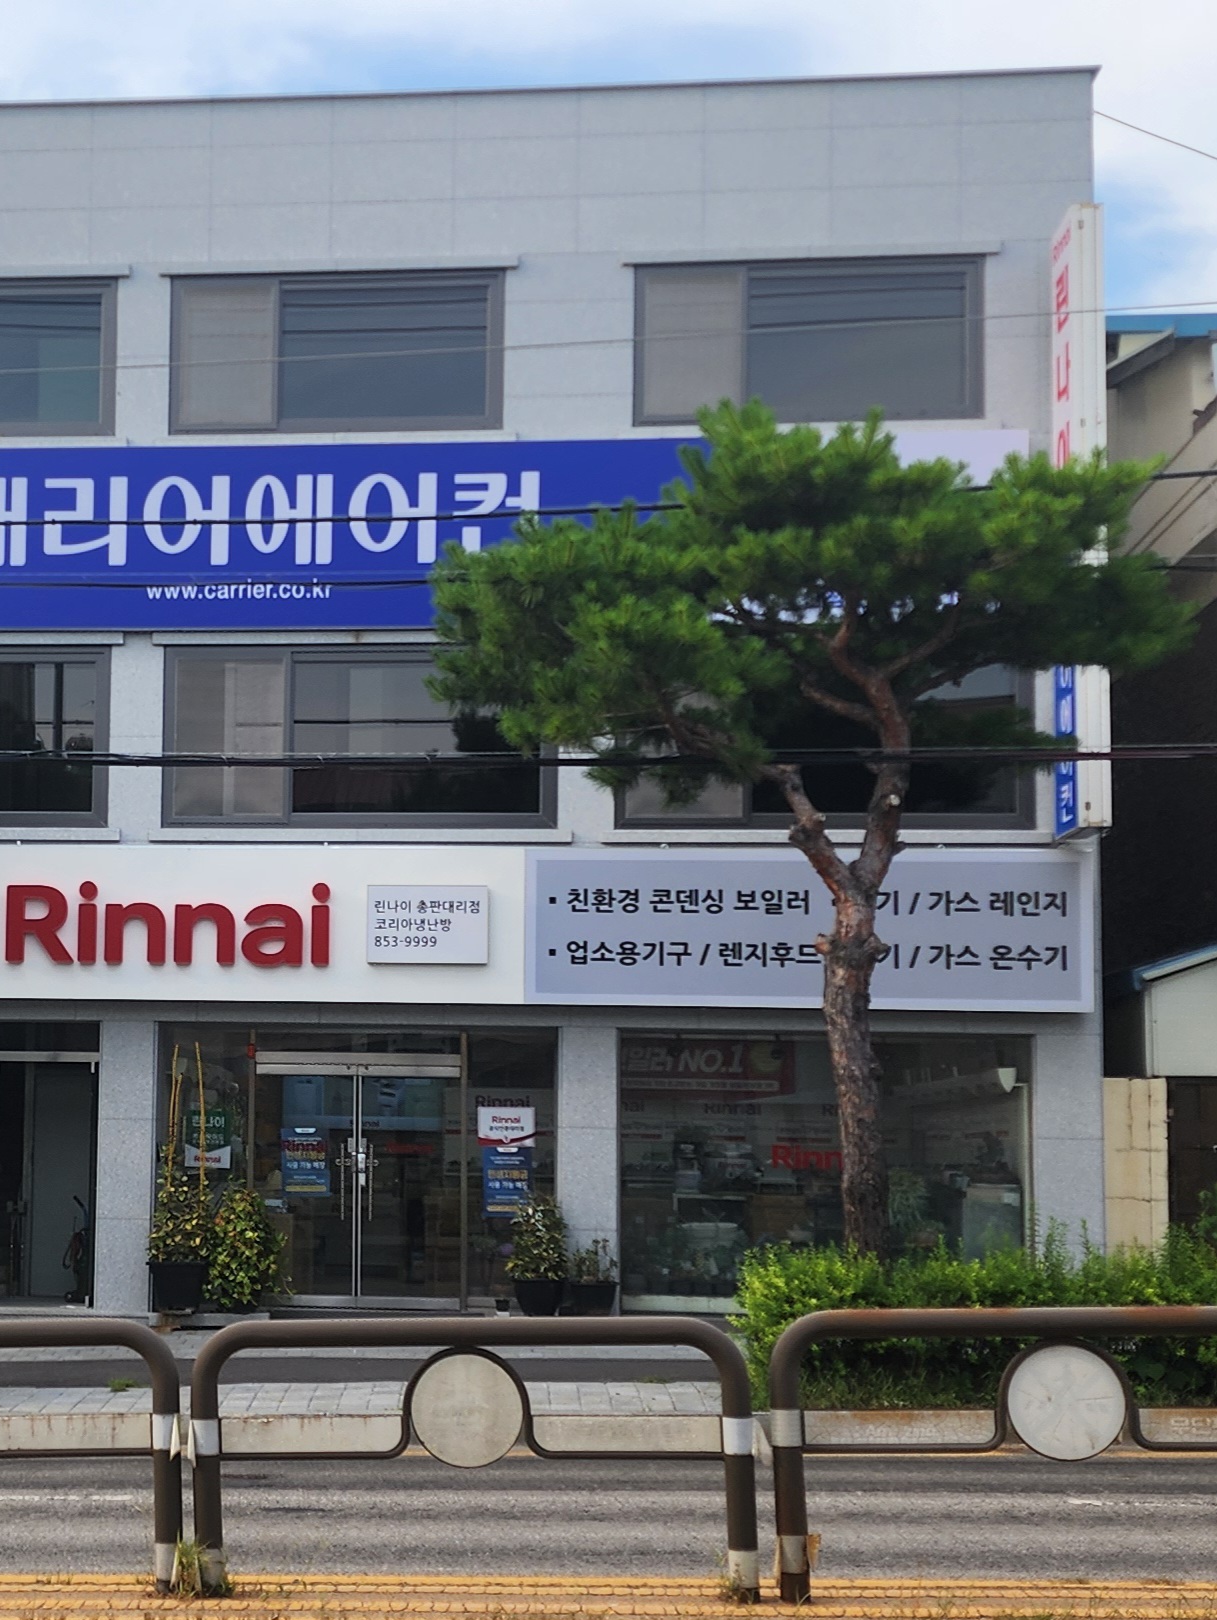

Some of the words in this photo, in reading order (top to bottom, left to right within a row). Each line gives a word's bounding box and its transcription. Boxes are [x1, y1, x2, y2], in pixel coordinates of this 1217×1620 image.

[146, 577, 333, 600] www.carrier.co.kr
[374, 899, 412, 914] 린나이
[416, 899, 481, 914] 총판대리점
[567, 888, 641, 914] 친환경
[649, 888, 724, 914] 콘덴싱
[733, 889, 810, 915] 보일러
[928, 890, 982, 916] 가스
[989, 890, 1068, 917] 레인지
[4, 881, 331, 966] Rinnai
[374, 917, 453, 932] 코리아냉난방
[374, 935, 438, 948] 853-9999
[566, 940, 693, 966] 업소용기구
[718, 941, 822, 968] 렌지후드
[928, 944, 982, 970] 가스
[989, 944, 1068, 971] 온수기
[676, 1043, 745, 1074] NO.1
[771, 1144, 842, 1169] Rinn
